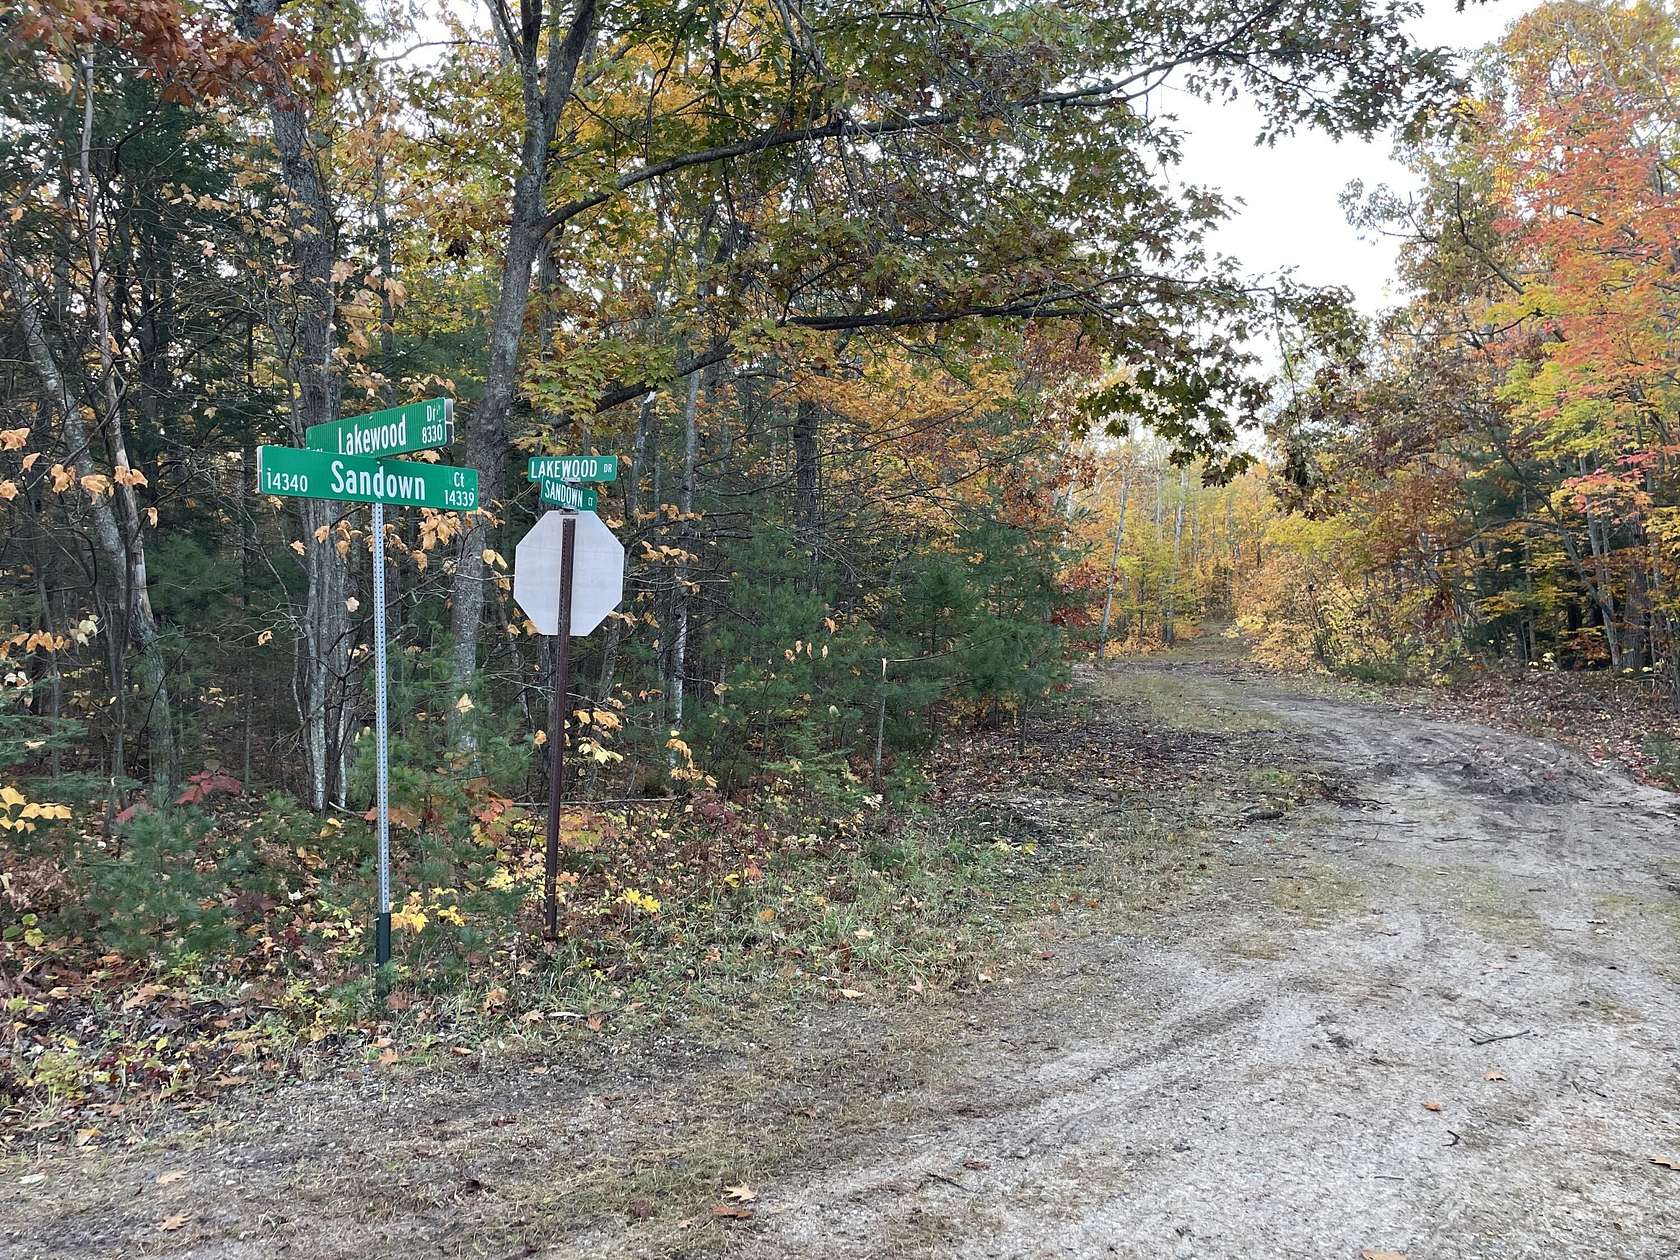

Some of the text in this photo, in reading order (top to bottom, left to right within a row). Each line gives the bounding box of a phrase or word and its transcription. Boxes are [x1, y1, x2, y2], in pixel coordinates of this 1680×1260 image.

[338, 405, 437, 456] Lakewood Dr
[422, 424, 443, 444] 8330
[266, 460, 465, 501] 14340 Sandown Ct
[531, 459, 613, 479] LAKEWOOD DR
[444, 489, 475, 507] 14339
[544, 480, 594, 508] SANDOWN CT
